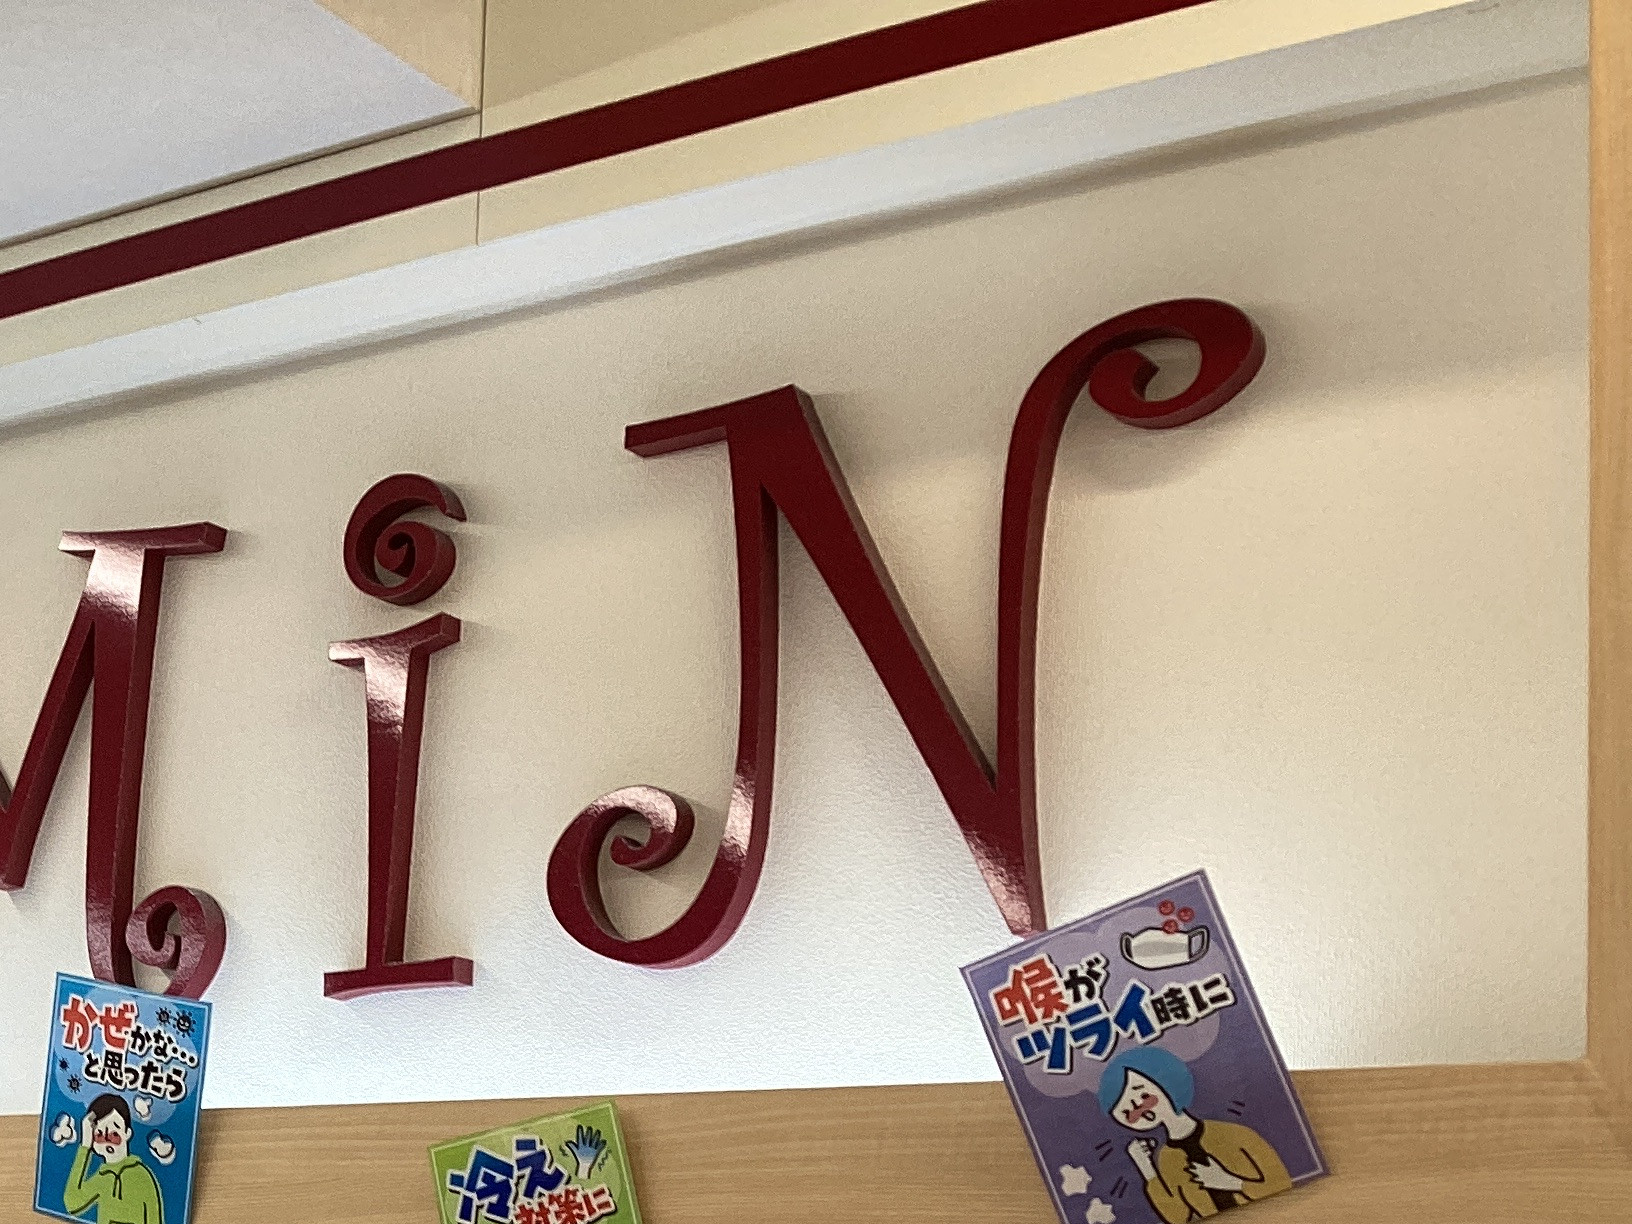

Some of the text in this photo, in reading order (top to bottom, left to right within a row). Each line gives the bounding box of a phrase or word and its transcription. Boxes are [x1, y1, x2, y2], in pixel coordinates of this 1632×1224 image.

[992, 954, 1111, 1028] 喉が
[1016, 975, 1236, 1073] ツライ時に
[84, 1051, 186, 1102] と思ったら
